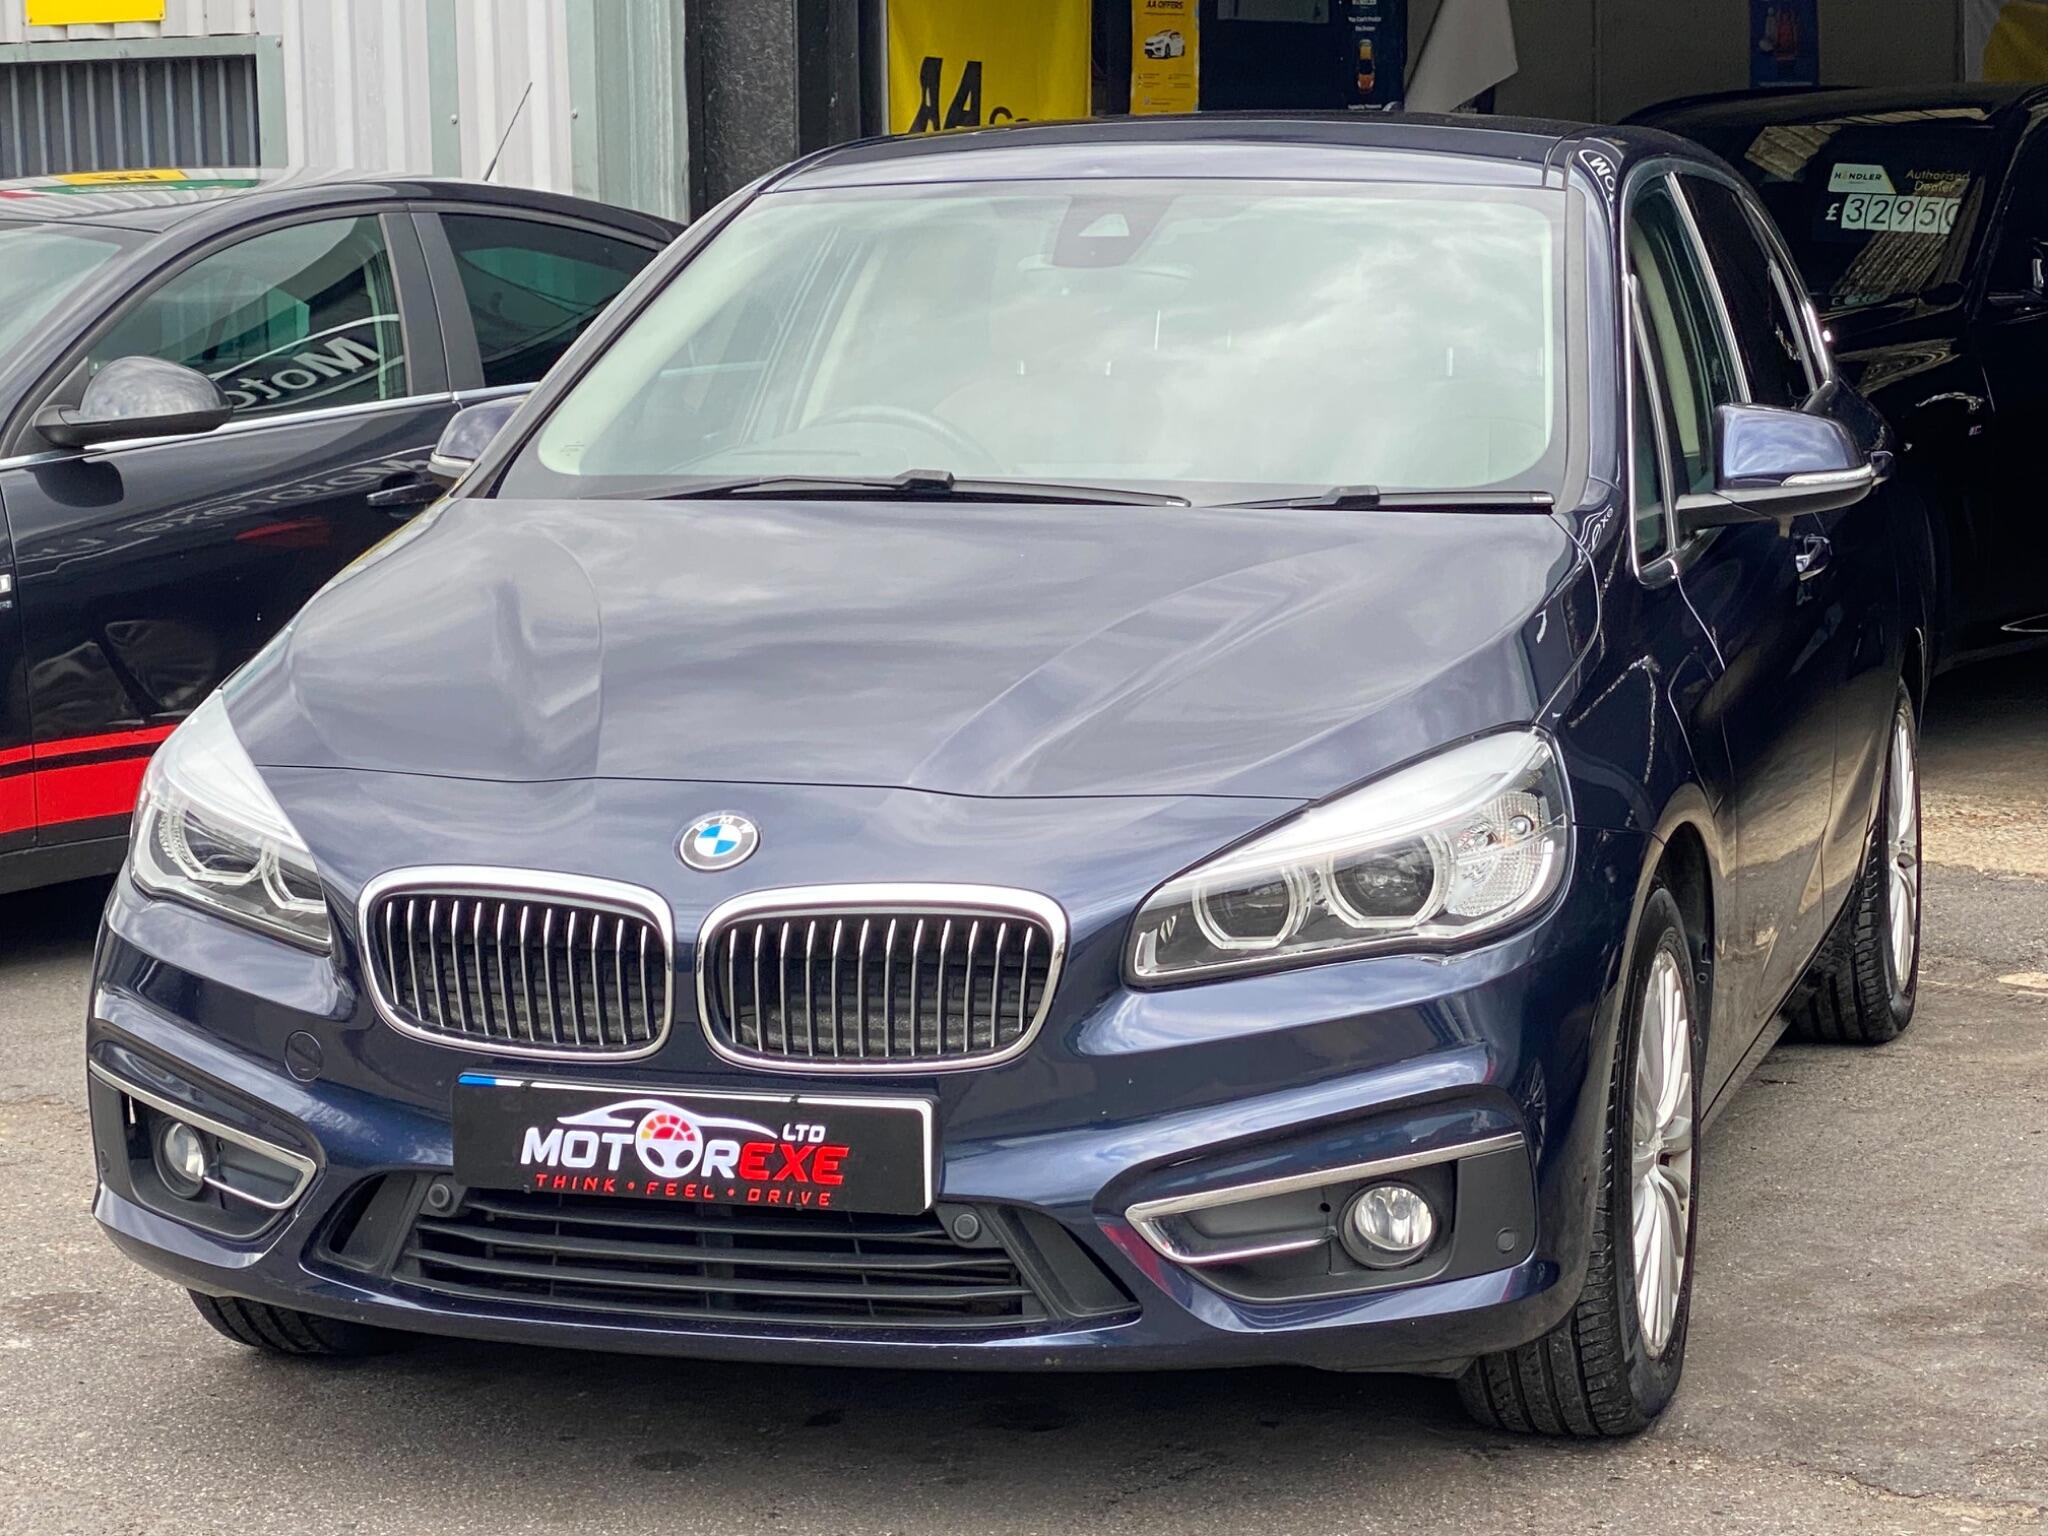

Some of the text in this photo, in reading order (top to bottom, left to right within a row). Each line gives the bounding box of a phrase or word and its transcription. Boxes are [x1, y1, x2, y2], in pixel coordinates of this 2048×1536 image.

[908, 57, 983, 133] AA
[695, 815, 755, 834] BMW
[782, 1122, 827, 1143] LTD
[535, 1173, 832, 1207] THINK FEEL DRIVE
